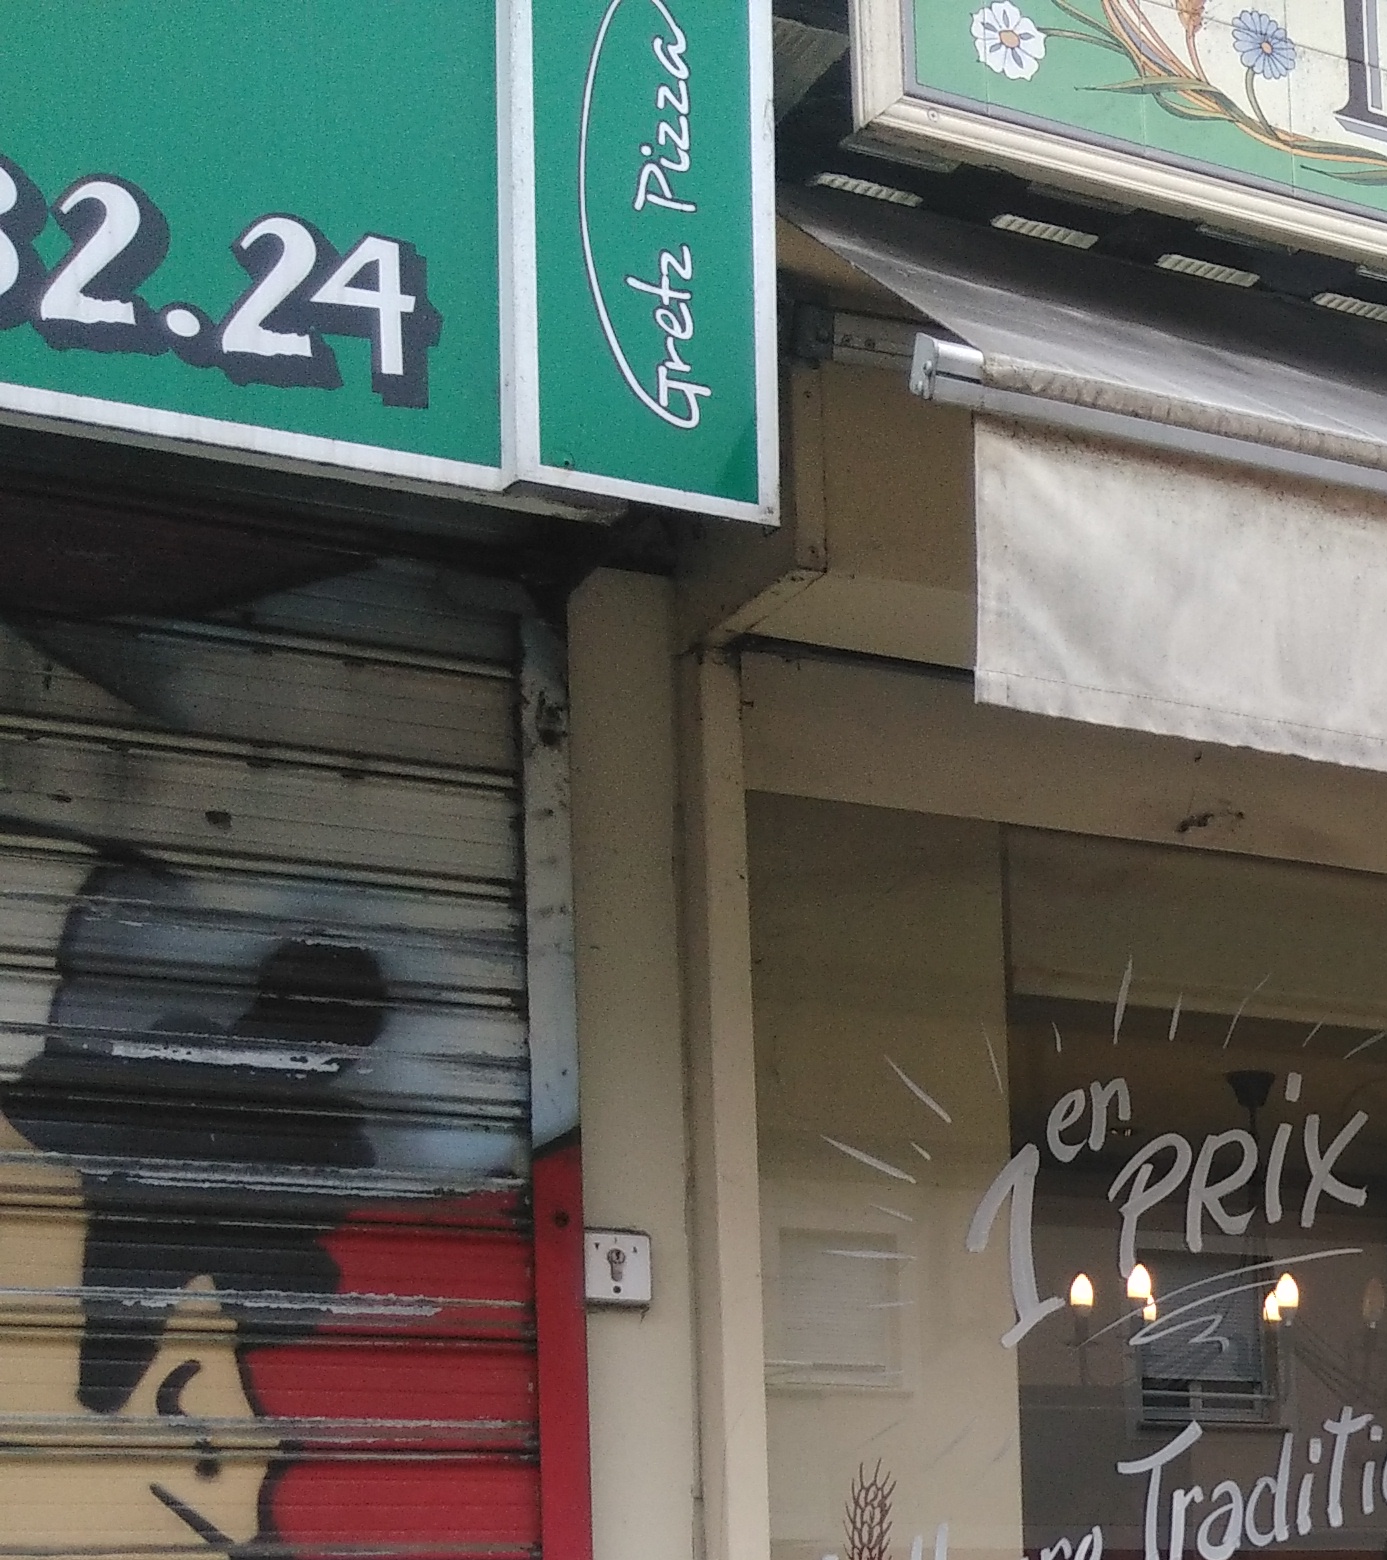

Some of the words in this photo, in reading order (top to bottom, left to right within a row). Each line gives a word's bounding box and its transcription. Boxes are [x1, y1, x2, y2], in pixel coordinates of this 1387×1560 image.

[634, 32, 698, 214] Pizza
[0, 158, 430, 392] 2.24
[626, 243, 712, 430] Gretz
